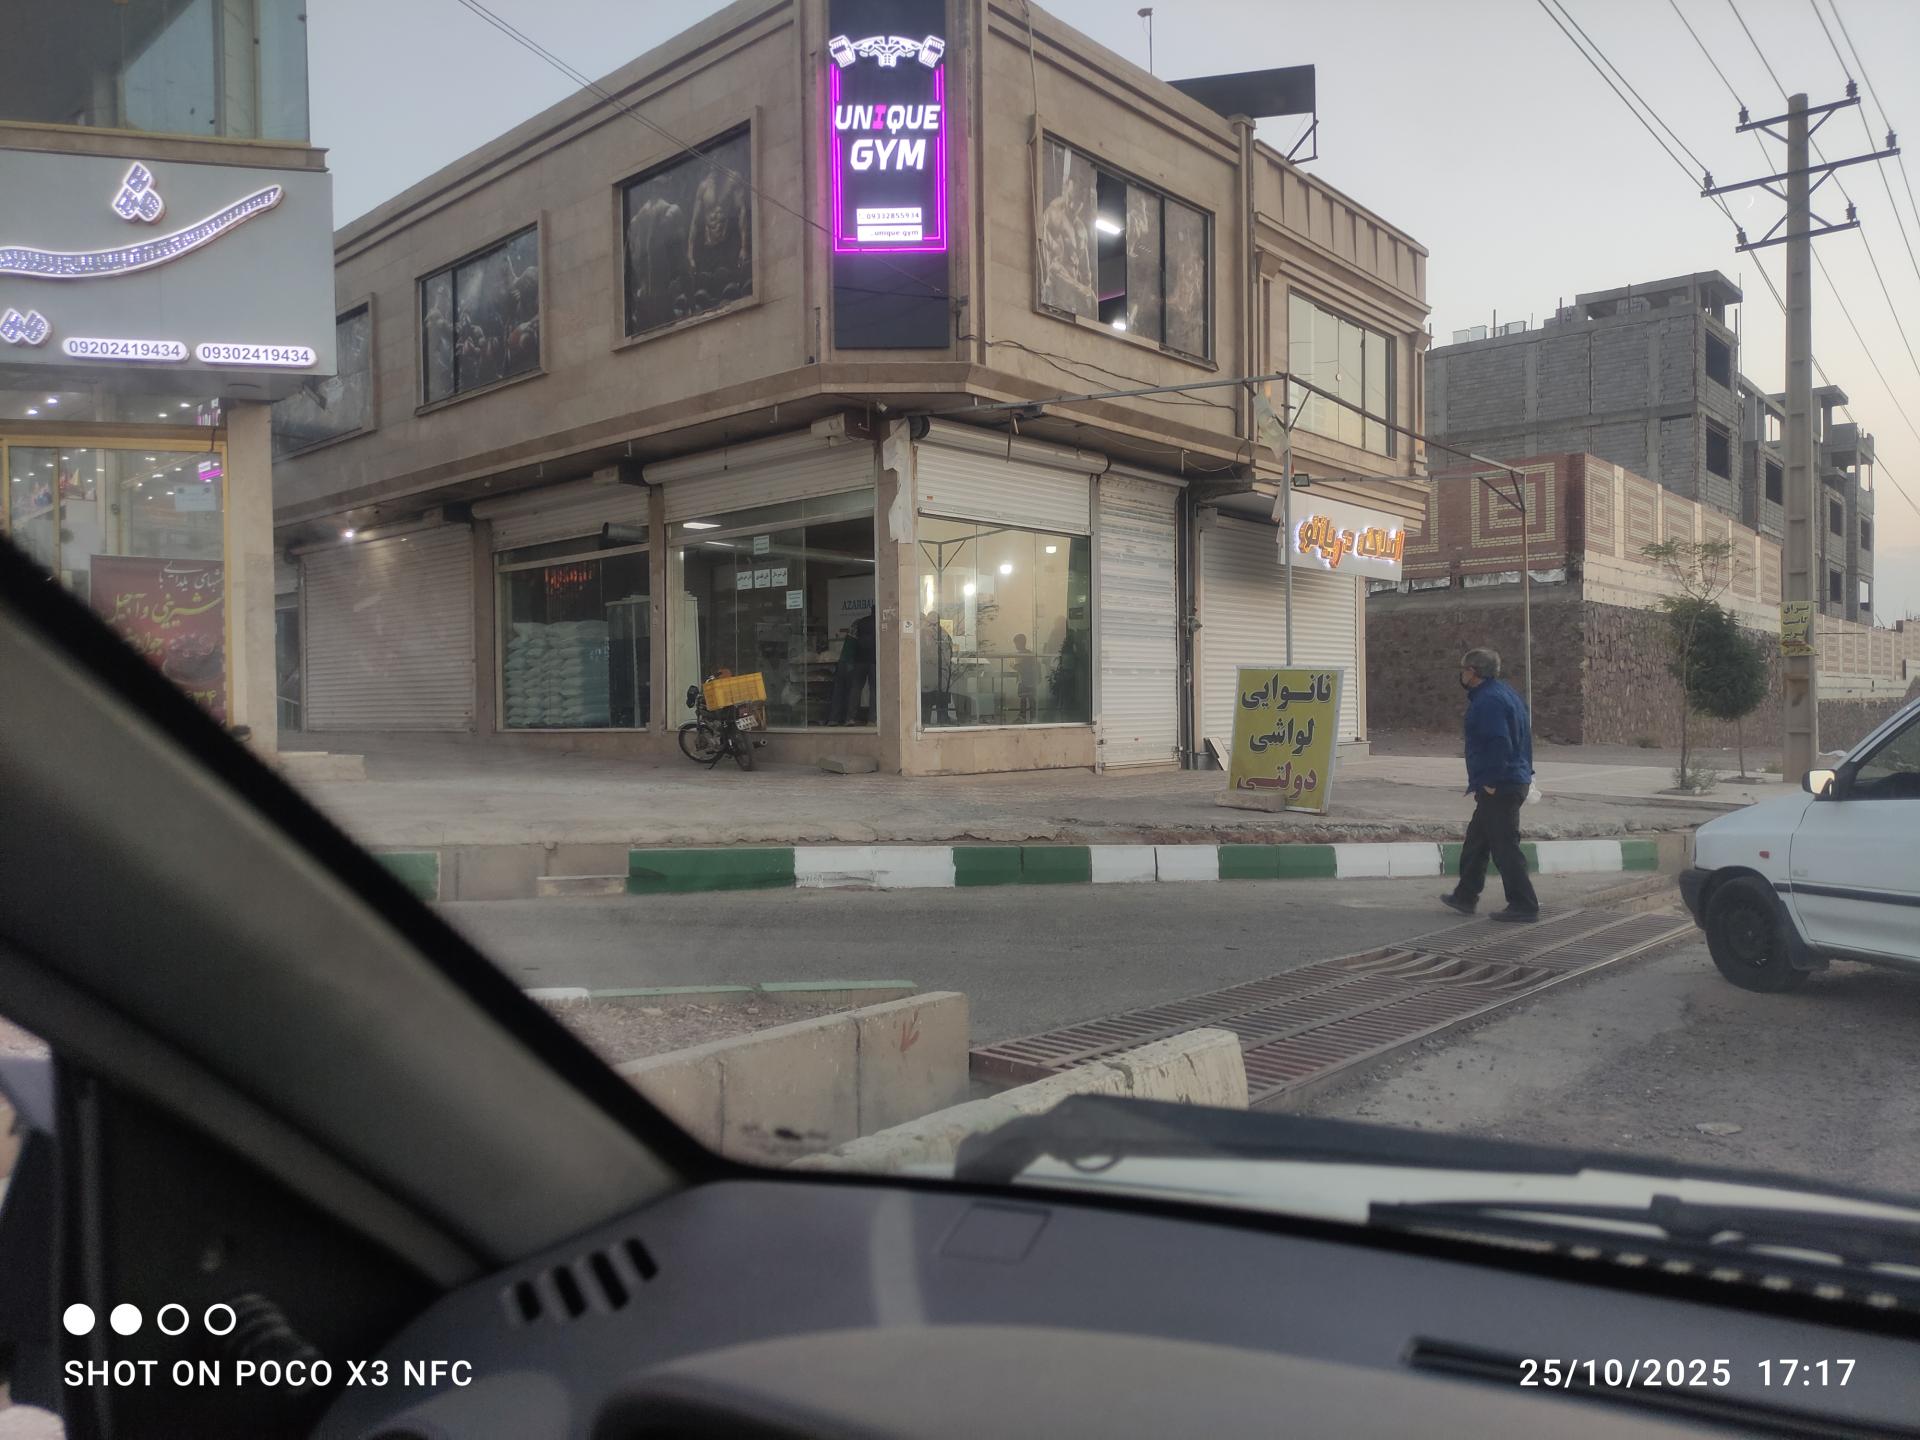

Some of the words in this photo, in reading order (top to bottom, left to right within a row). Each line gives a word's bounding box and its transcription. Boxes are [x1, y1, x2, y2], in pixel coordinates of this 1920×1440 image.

[835, 105, 941, 134] UNIQUE
[850, 139, 926, 170] GYM
[69, 340, 181, 357] 09202419434
[202, 346, 310, 363] 09302419434
[1241, 673, 1331, 709] نانوایی
[1250, 718, 1315, 755] لواشی
[1236, 761, 1317, 799] دولتی
